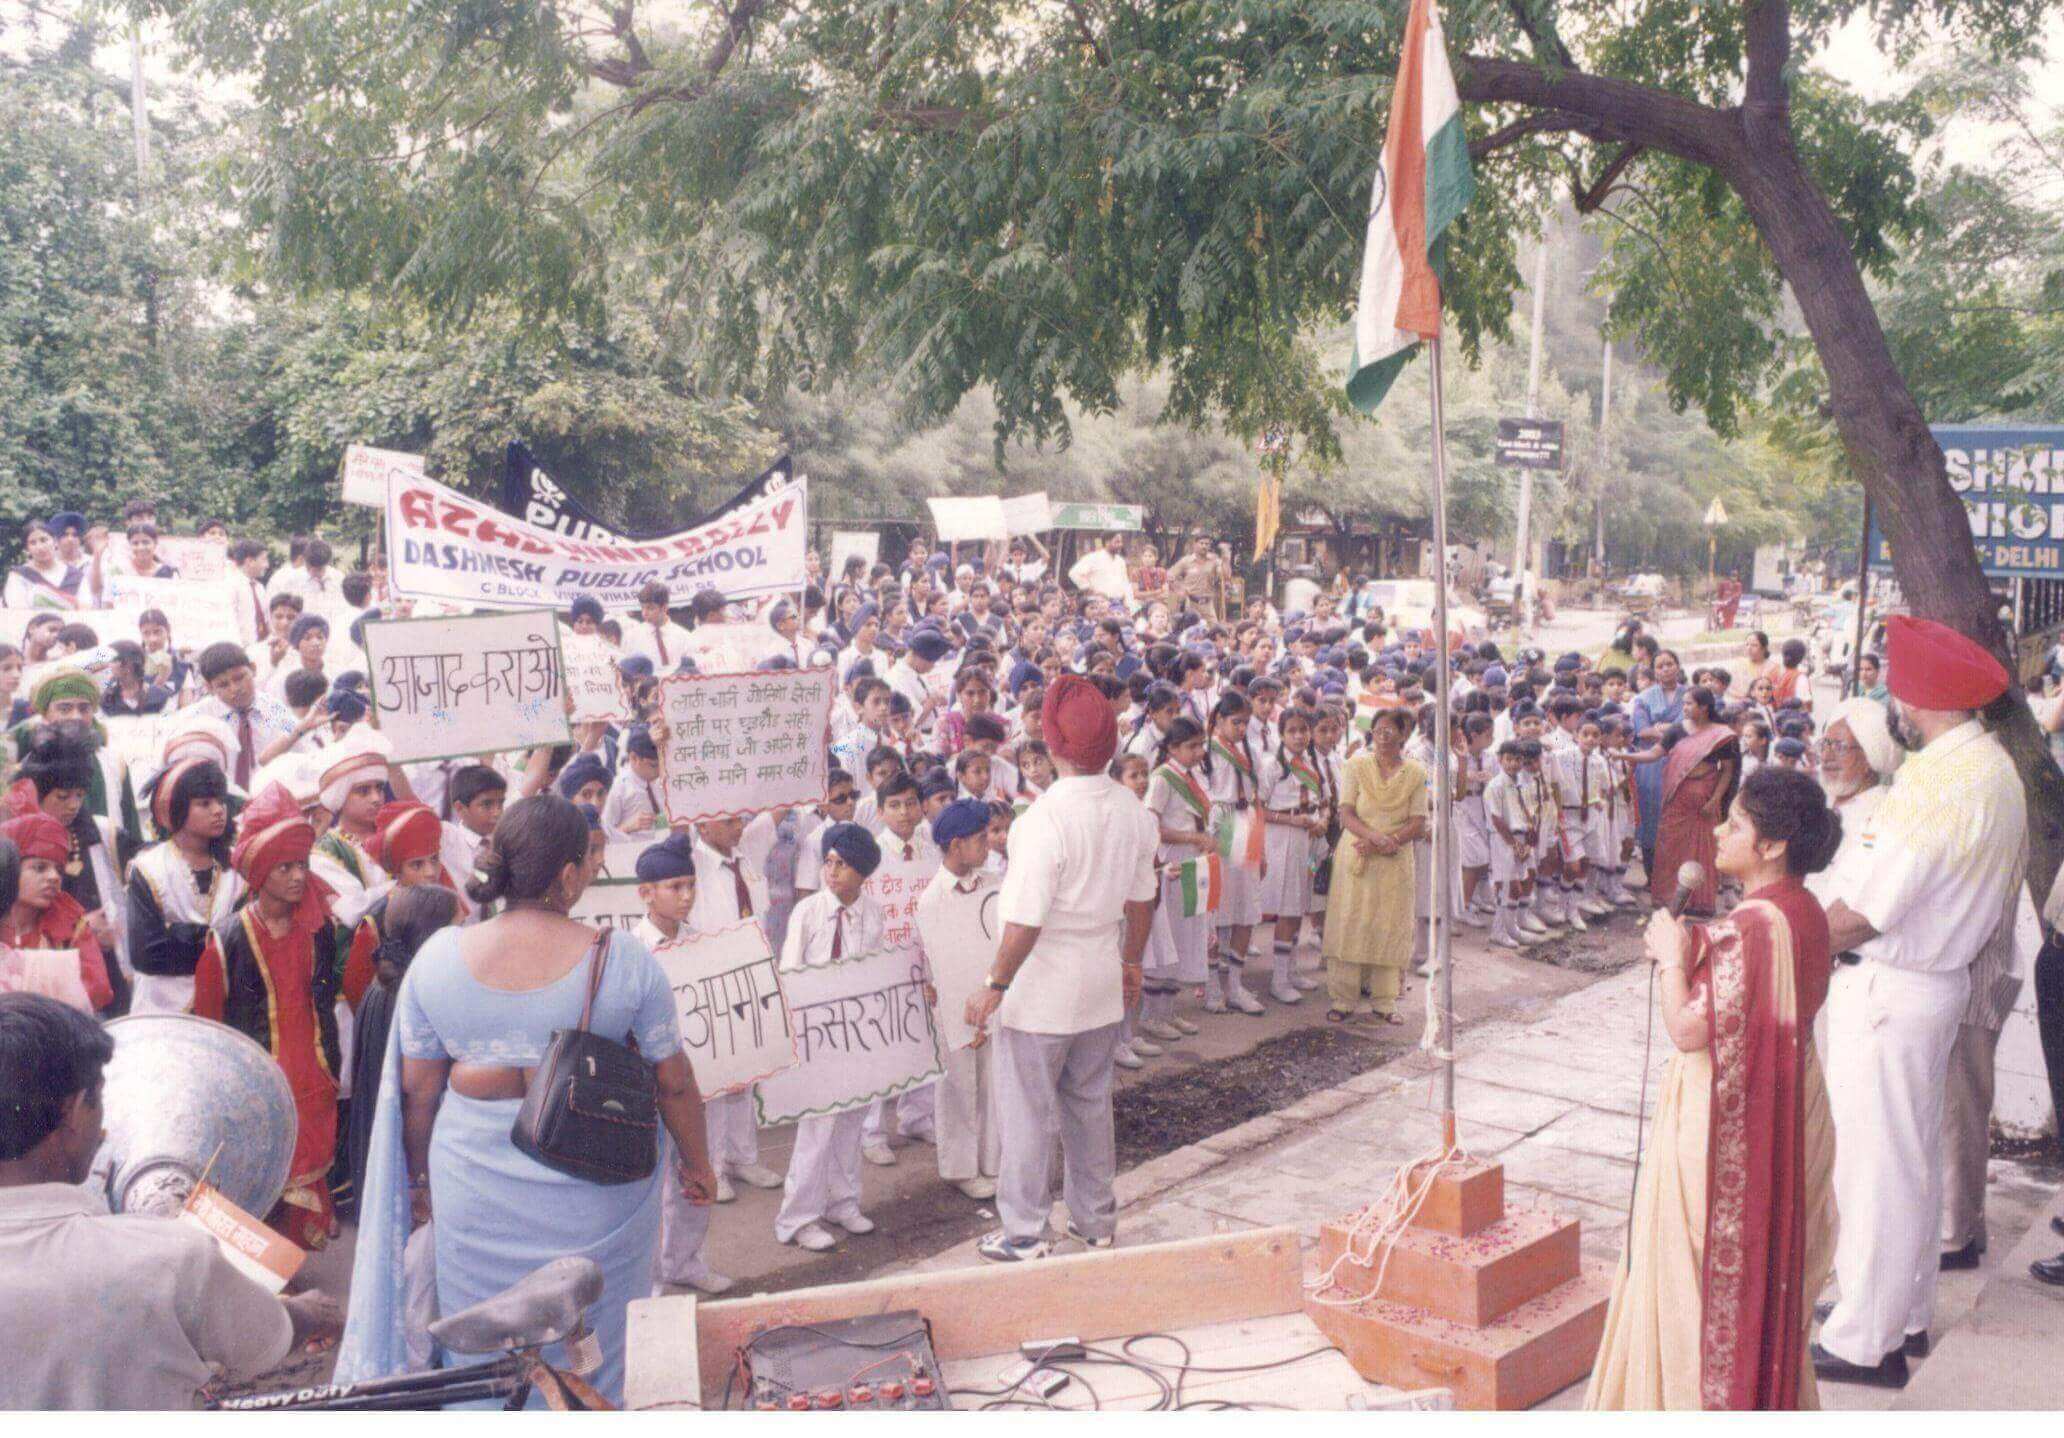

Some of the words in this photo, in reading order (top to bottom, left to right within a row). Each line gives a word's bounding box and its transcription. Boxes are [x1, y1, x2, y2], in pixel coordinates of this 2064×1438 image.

[404, 538, 547, 583] DASHMESH
[556, 569, 659, 588] PUBLIC
[665, 545, 767, 580] SCHOOL
[480, 582, 491, 594] C
[378, 653, 468, 714] आजाद
[470, 634, 560, 705] कराओ
[712, 718, 734, 736] पर
[672, 957, 790, 1059] अपमान
